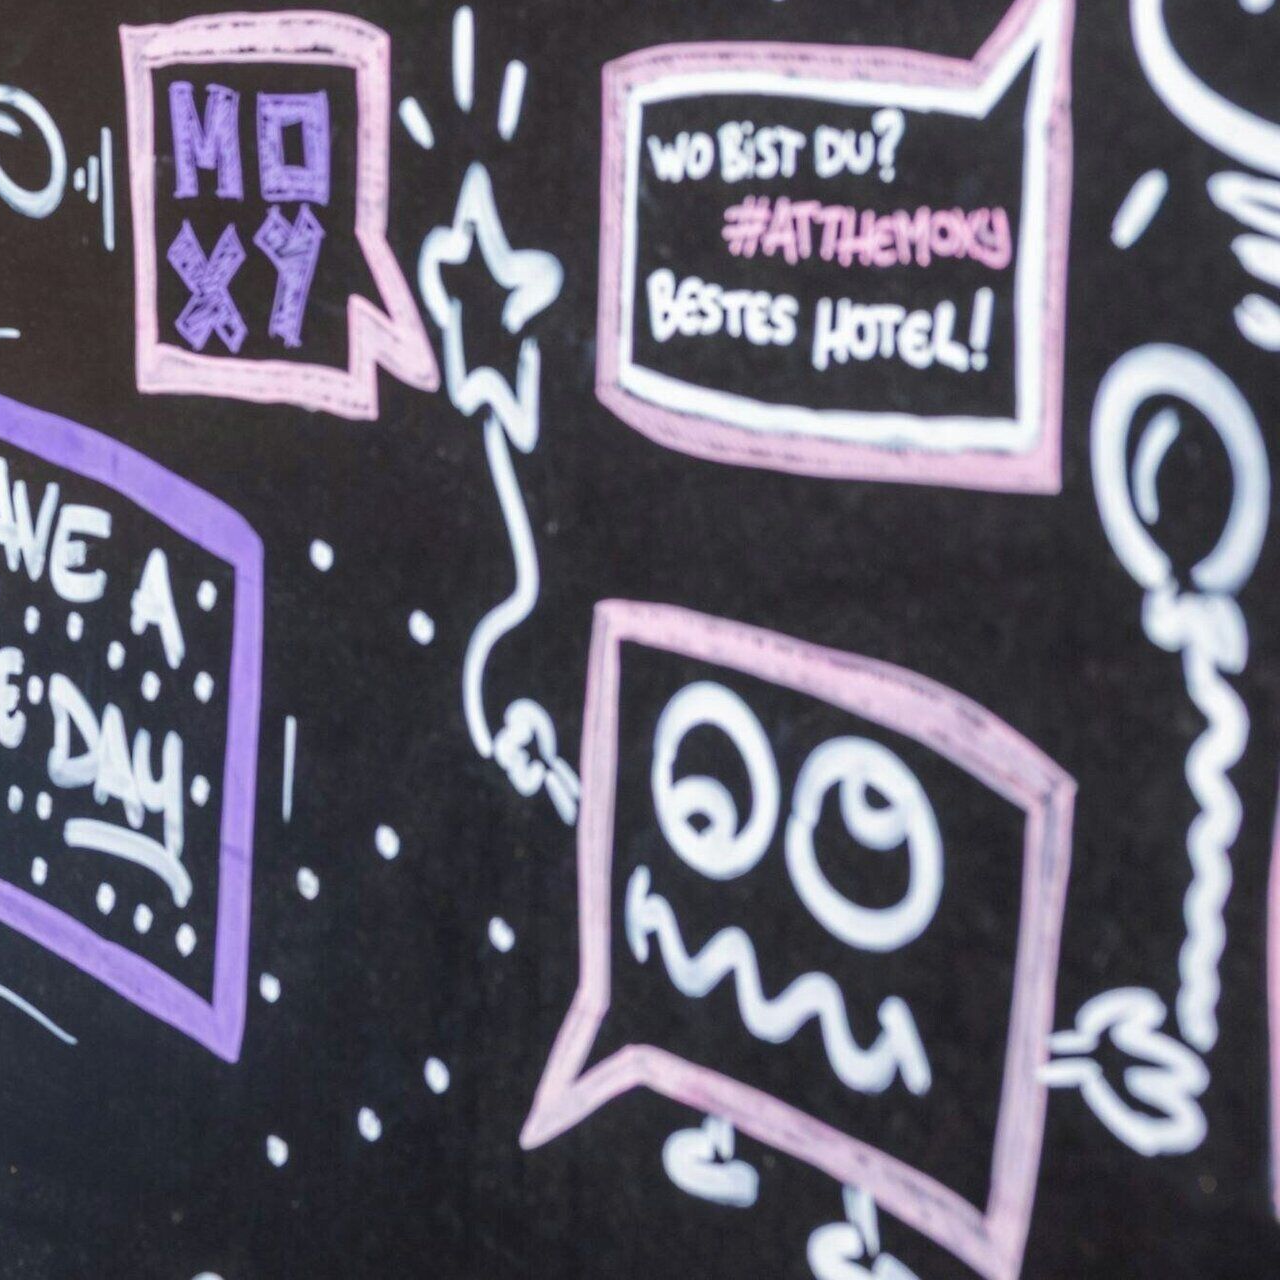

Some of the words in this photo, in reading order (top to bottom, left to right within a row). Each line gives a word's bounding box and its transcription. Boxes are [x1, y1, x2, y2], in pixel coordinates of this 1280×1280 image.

[168, 81, 330, 206] MO
[646, 131, 716, 183] WO
[813, 107, 906, 183] DU?
[167, 204, 327, 353] XY
[646, 268, 800, 346] BESTES
[812, 287, 995, 372] HOTEL!
[130, 548, 185, 669] A
[47, 673, 184, 858] DAY
